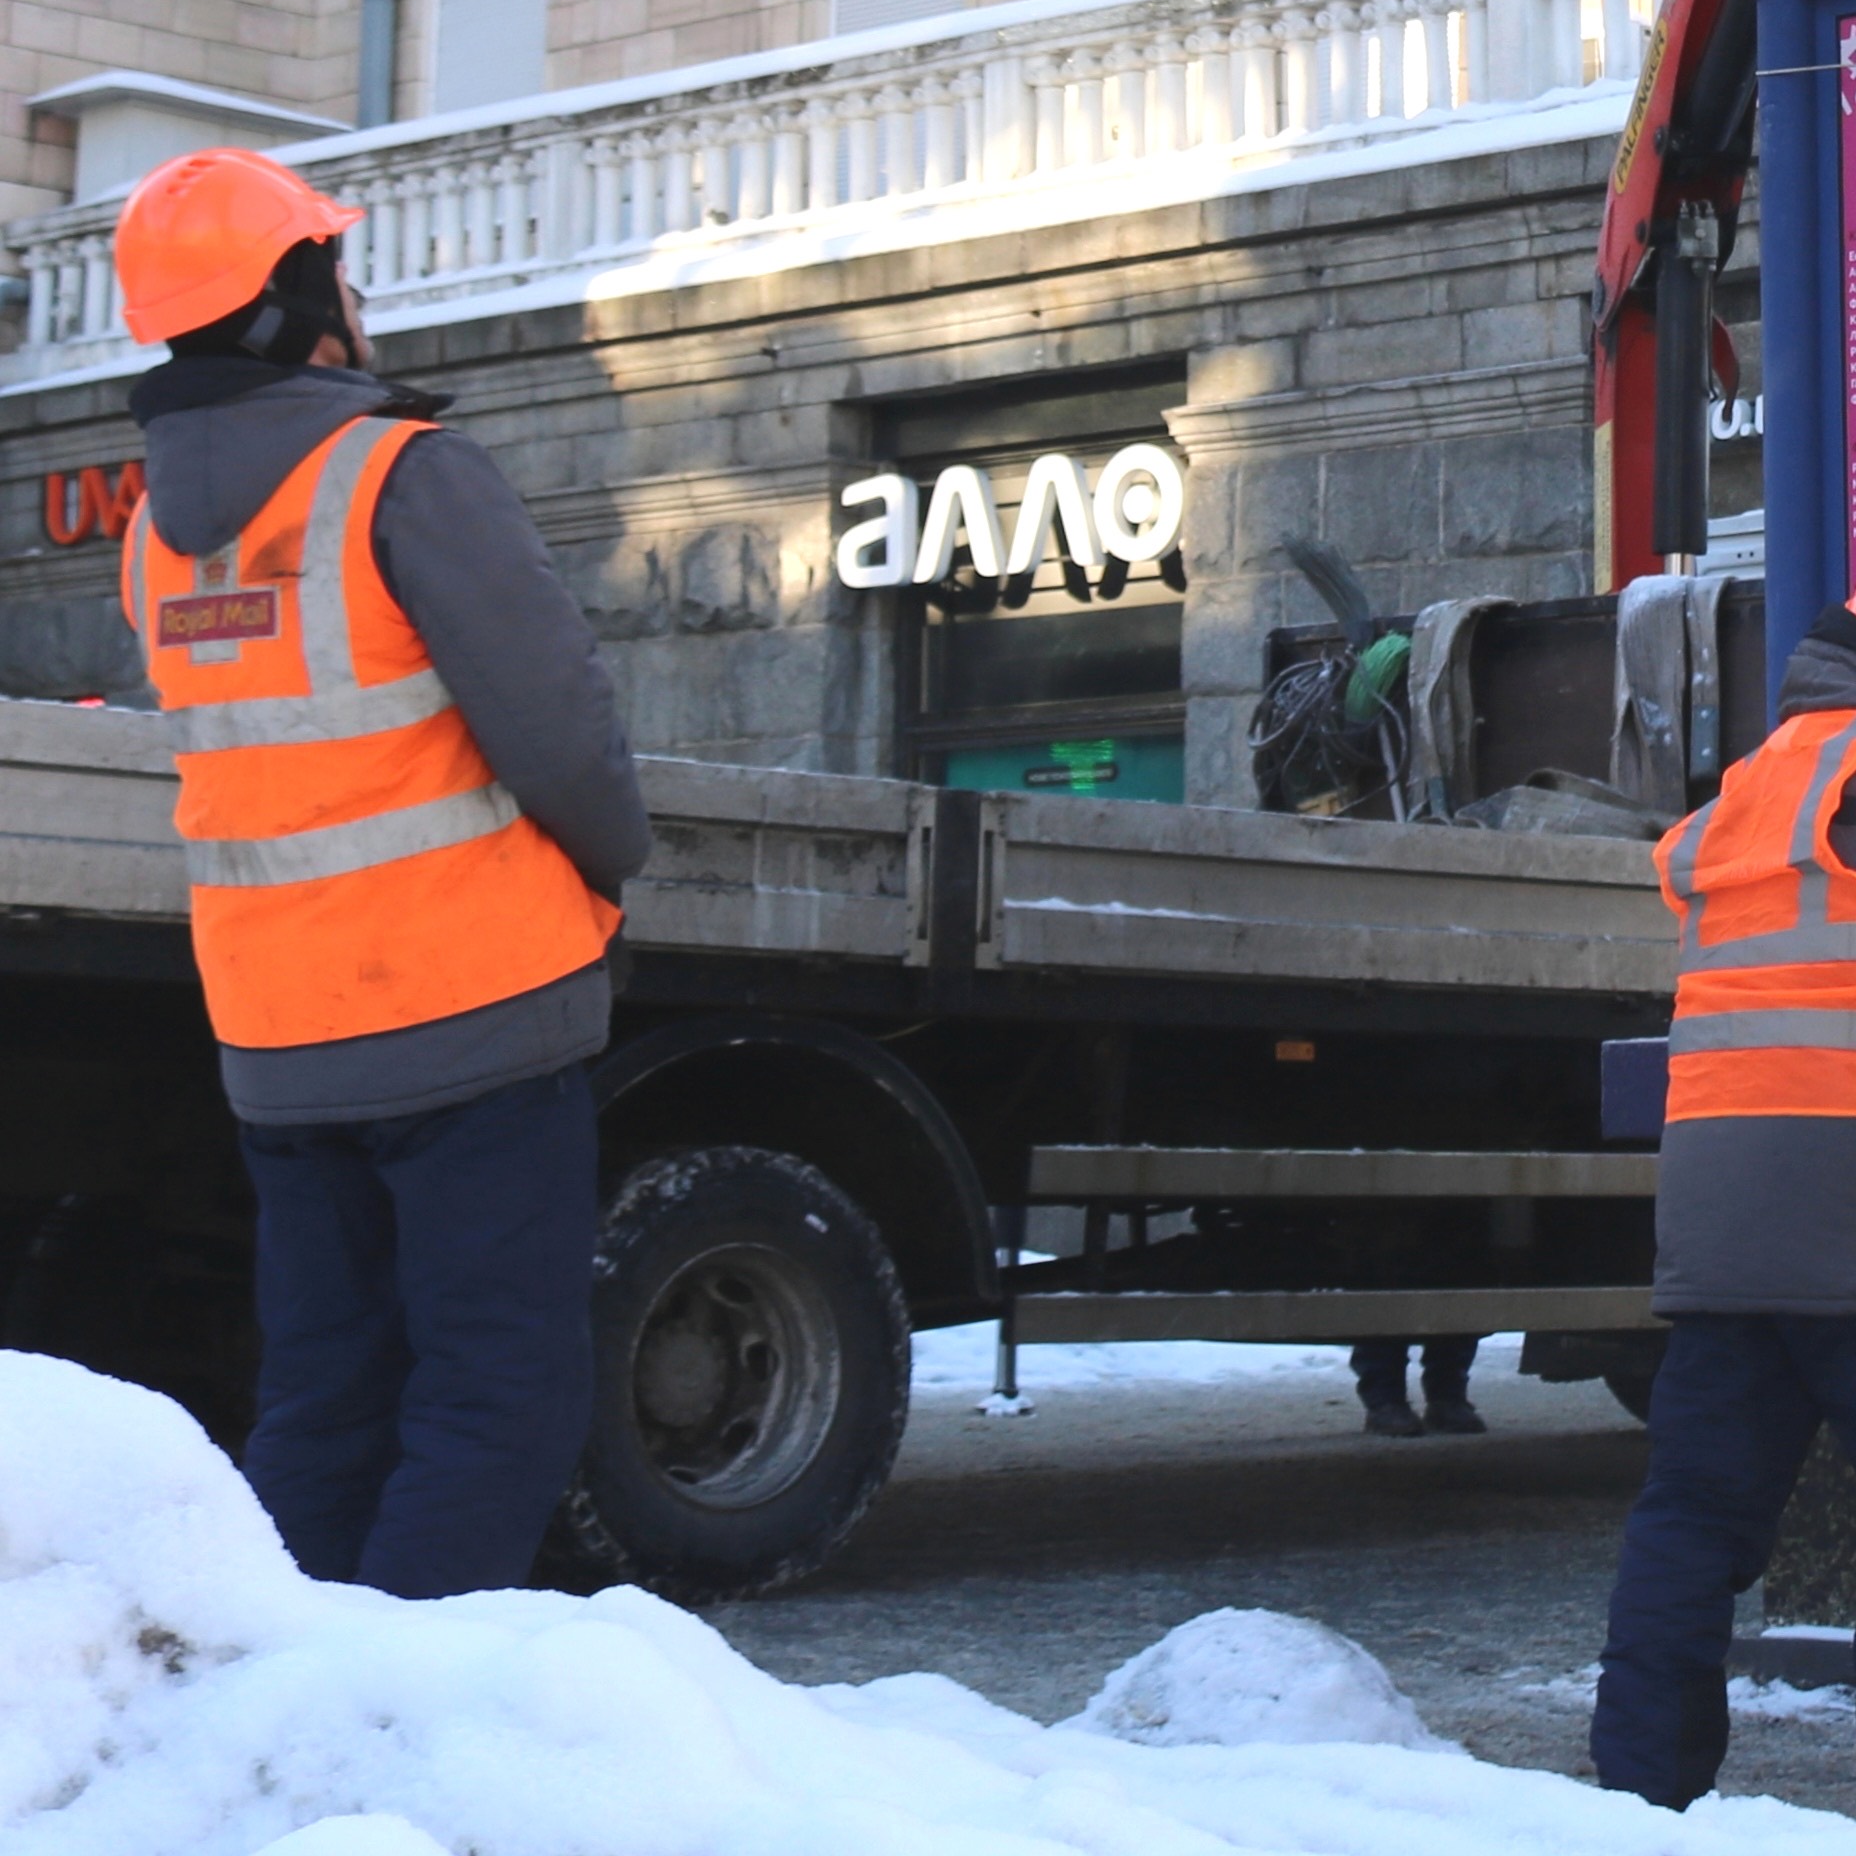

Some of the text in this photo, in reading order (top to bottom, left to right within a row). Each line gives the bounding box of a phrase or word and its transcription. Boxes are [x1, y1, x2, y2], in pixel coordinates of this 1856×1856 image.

[1616, 28, 1666, 185] PALFINGER
[164, 598, 269, 637] Royal Mail
